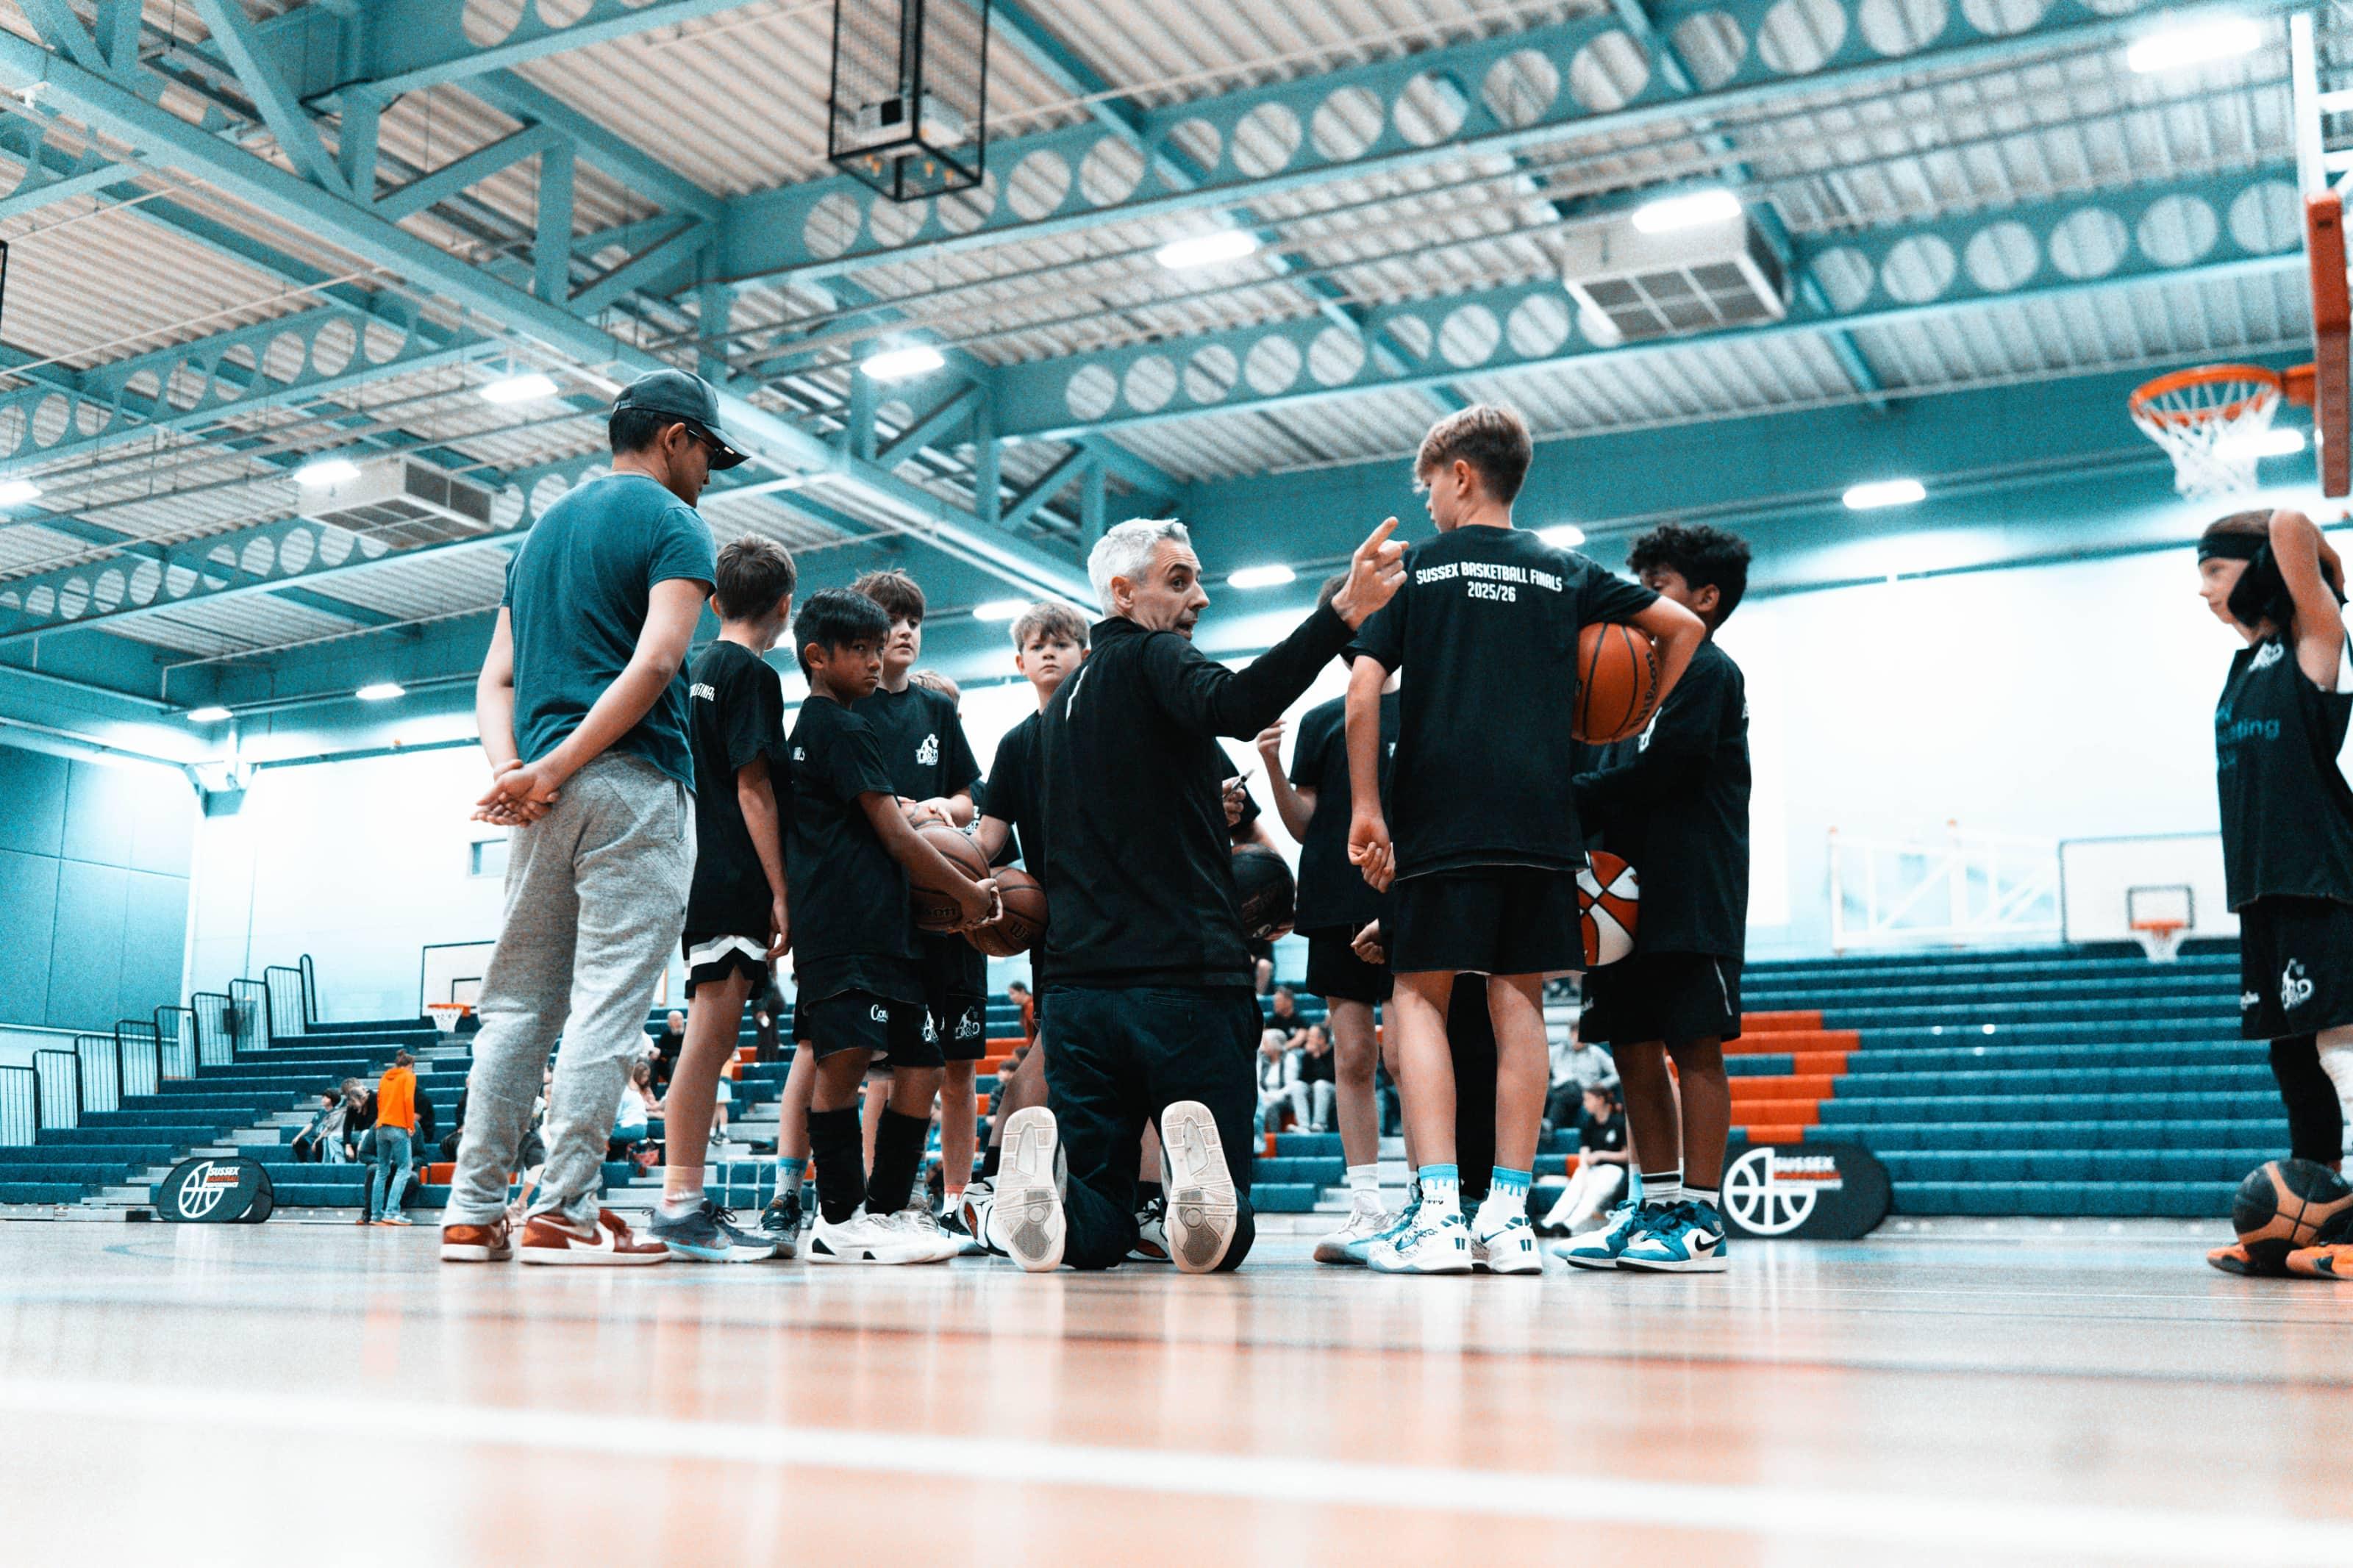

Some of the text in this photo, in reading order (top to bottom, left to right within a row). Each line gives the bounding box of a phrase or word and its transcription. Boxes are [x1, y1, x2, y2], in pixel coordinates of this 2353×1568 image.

[1415, 561, 1563, 593] SUSSEX BASKETBALL FINALS
[1467, 581, 1516, 602] 2025/26
[209, 1166, 240, 1176] SUSSEX
